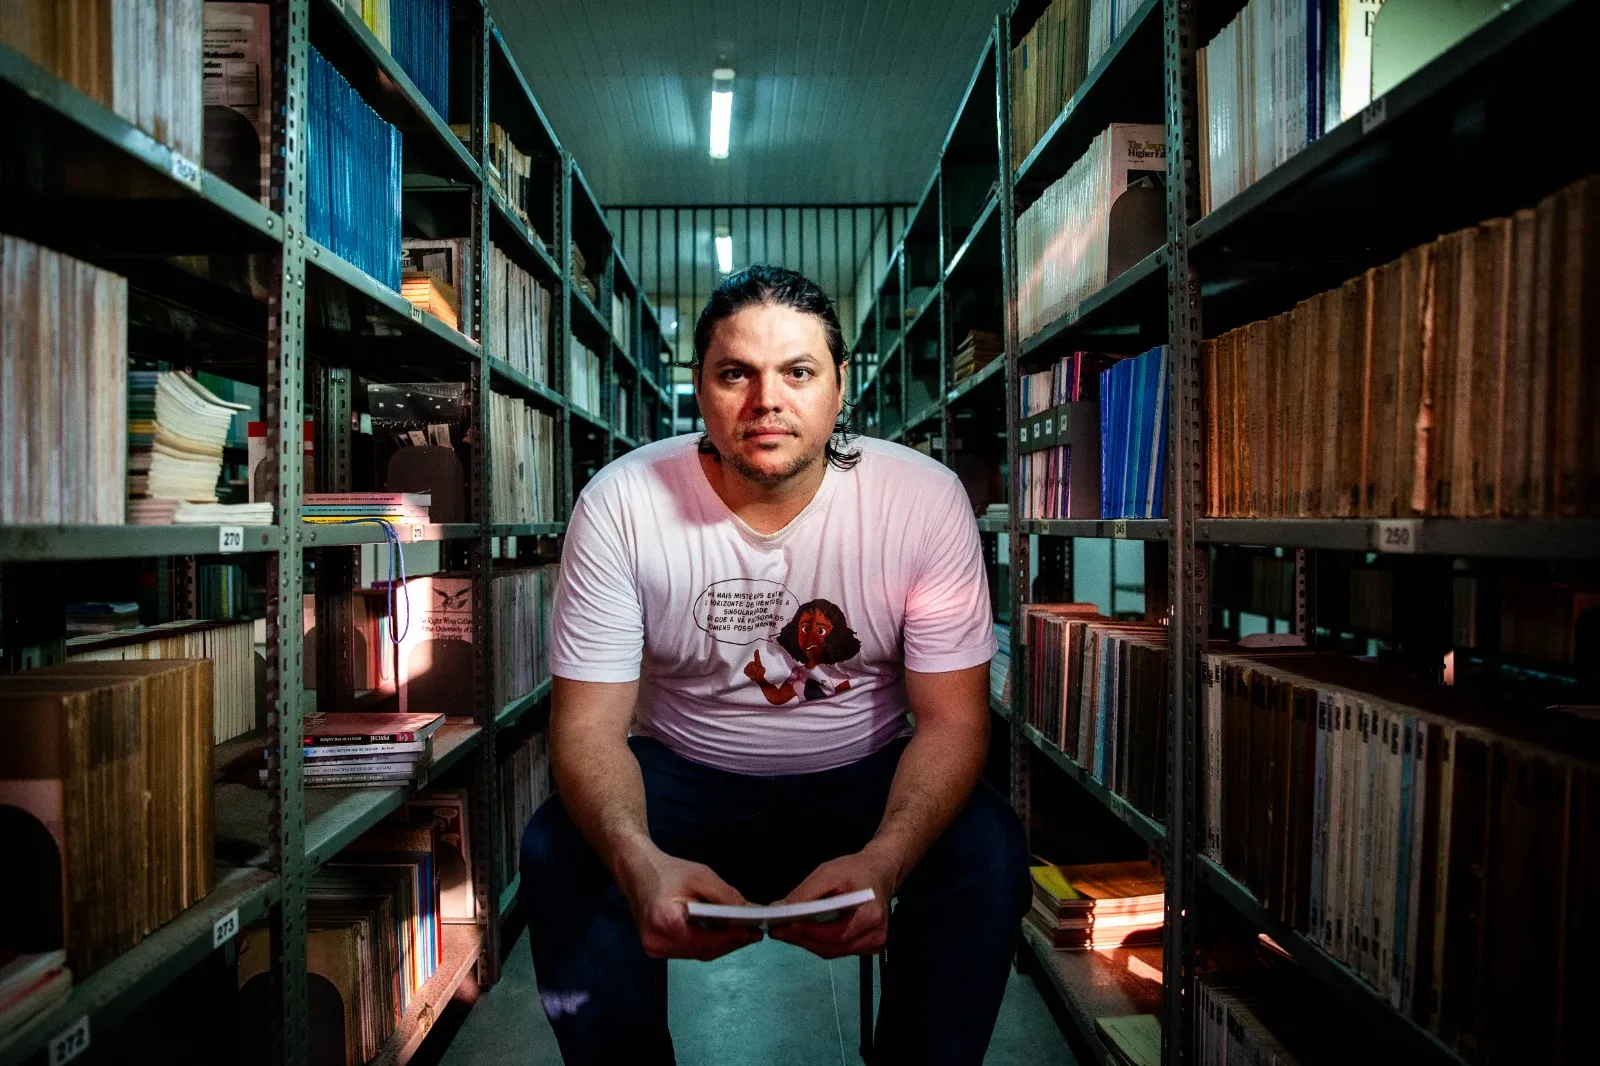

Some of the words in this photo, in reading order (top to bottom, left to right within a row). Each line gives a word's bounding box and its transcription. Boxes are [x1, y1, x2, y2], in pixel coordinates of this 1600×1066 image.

[1144, 141, 1166, 150] Jour
[1128, 148, 1154, 159] Higher
[1154, 150, 1166, 158] Ed
[224, 532, 240, 546] 270
[1385, 526, 1410, 544] 250
[428, 617, 442, 625] Right
[443, 617, 456, 625] Wing
[217, 918, 234, 940] 273
[57, 1028, 85, 1062] 272
